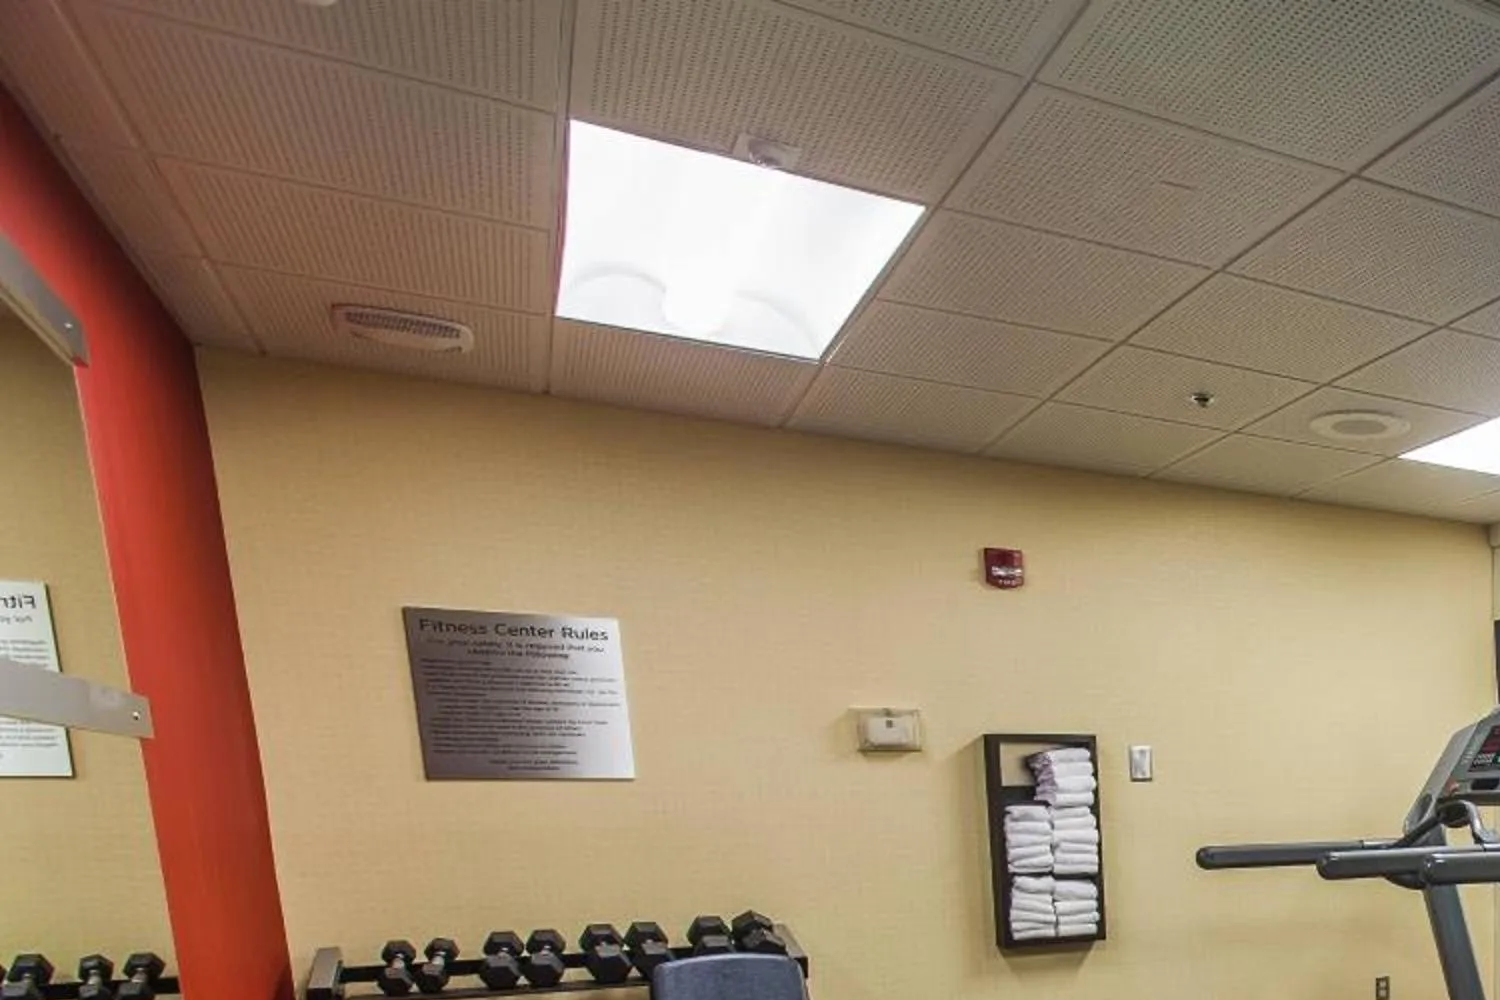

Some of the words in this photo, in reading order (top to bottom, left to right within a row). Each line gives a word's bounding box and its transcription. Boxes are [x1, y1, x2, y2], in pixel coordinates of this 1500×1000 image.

[419, 618, 487, 635] Fitness
[494, 622, 555, 638] Center
[561, 626, 609, 641] Rules
